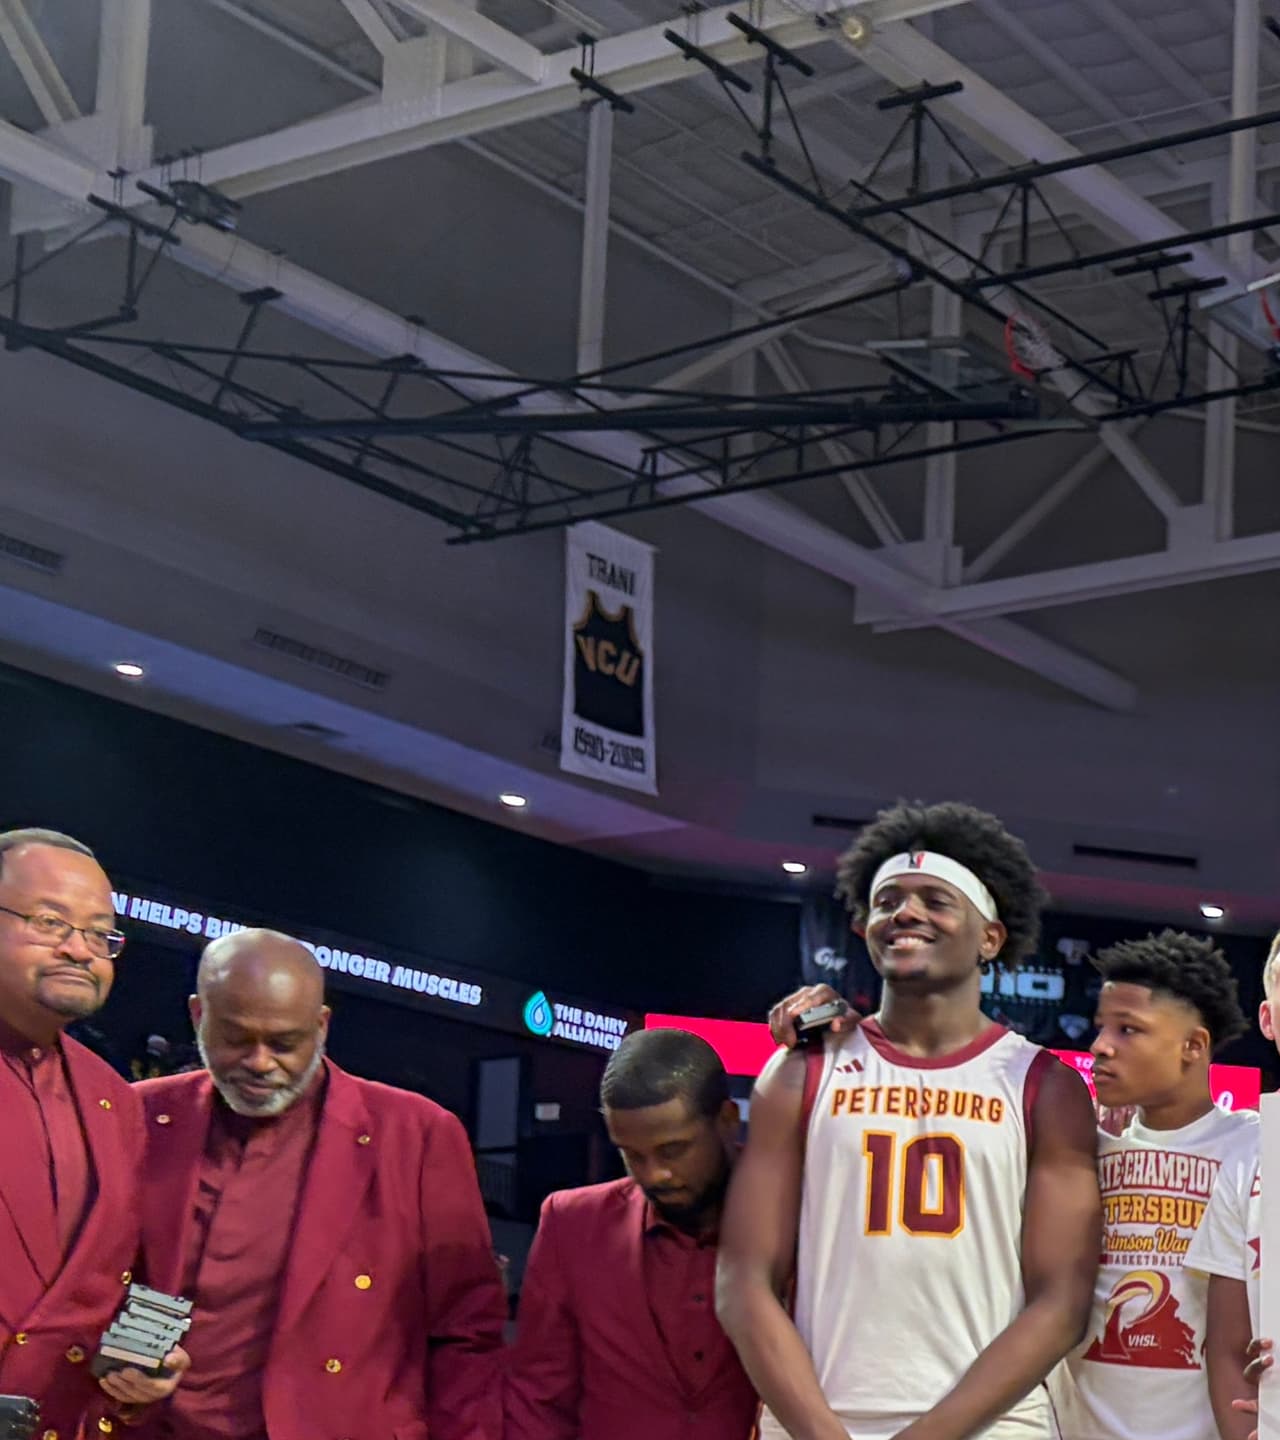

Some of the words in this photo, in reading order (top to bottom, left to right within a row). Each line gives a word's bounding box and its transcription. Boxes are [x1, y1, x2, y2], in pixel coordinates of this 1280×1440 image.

[576, 634, 641, 688] VCU
[130, 897, 203, 935] HELPS
[391, 966, 483, 1006] MUSCLES
[554, 1003, 582, 1025] THE
[583, 1011, 628, 1036] DAIRY
[830, 1085, 1006, 1125] PETERSBURG
[861, 1129, 966, 1240] 10
[1103, 1193, 1208, 1231] TERSBU
[1105, 1227, 1154, 1253] rimson
[1128, 1333, 1159, 1348] VHSL
